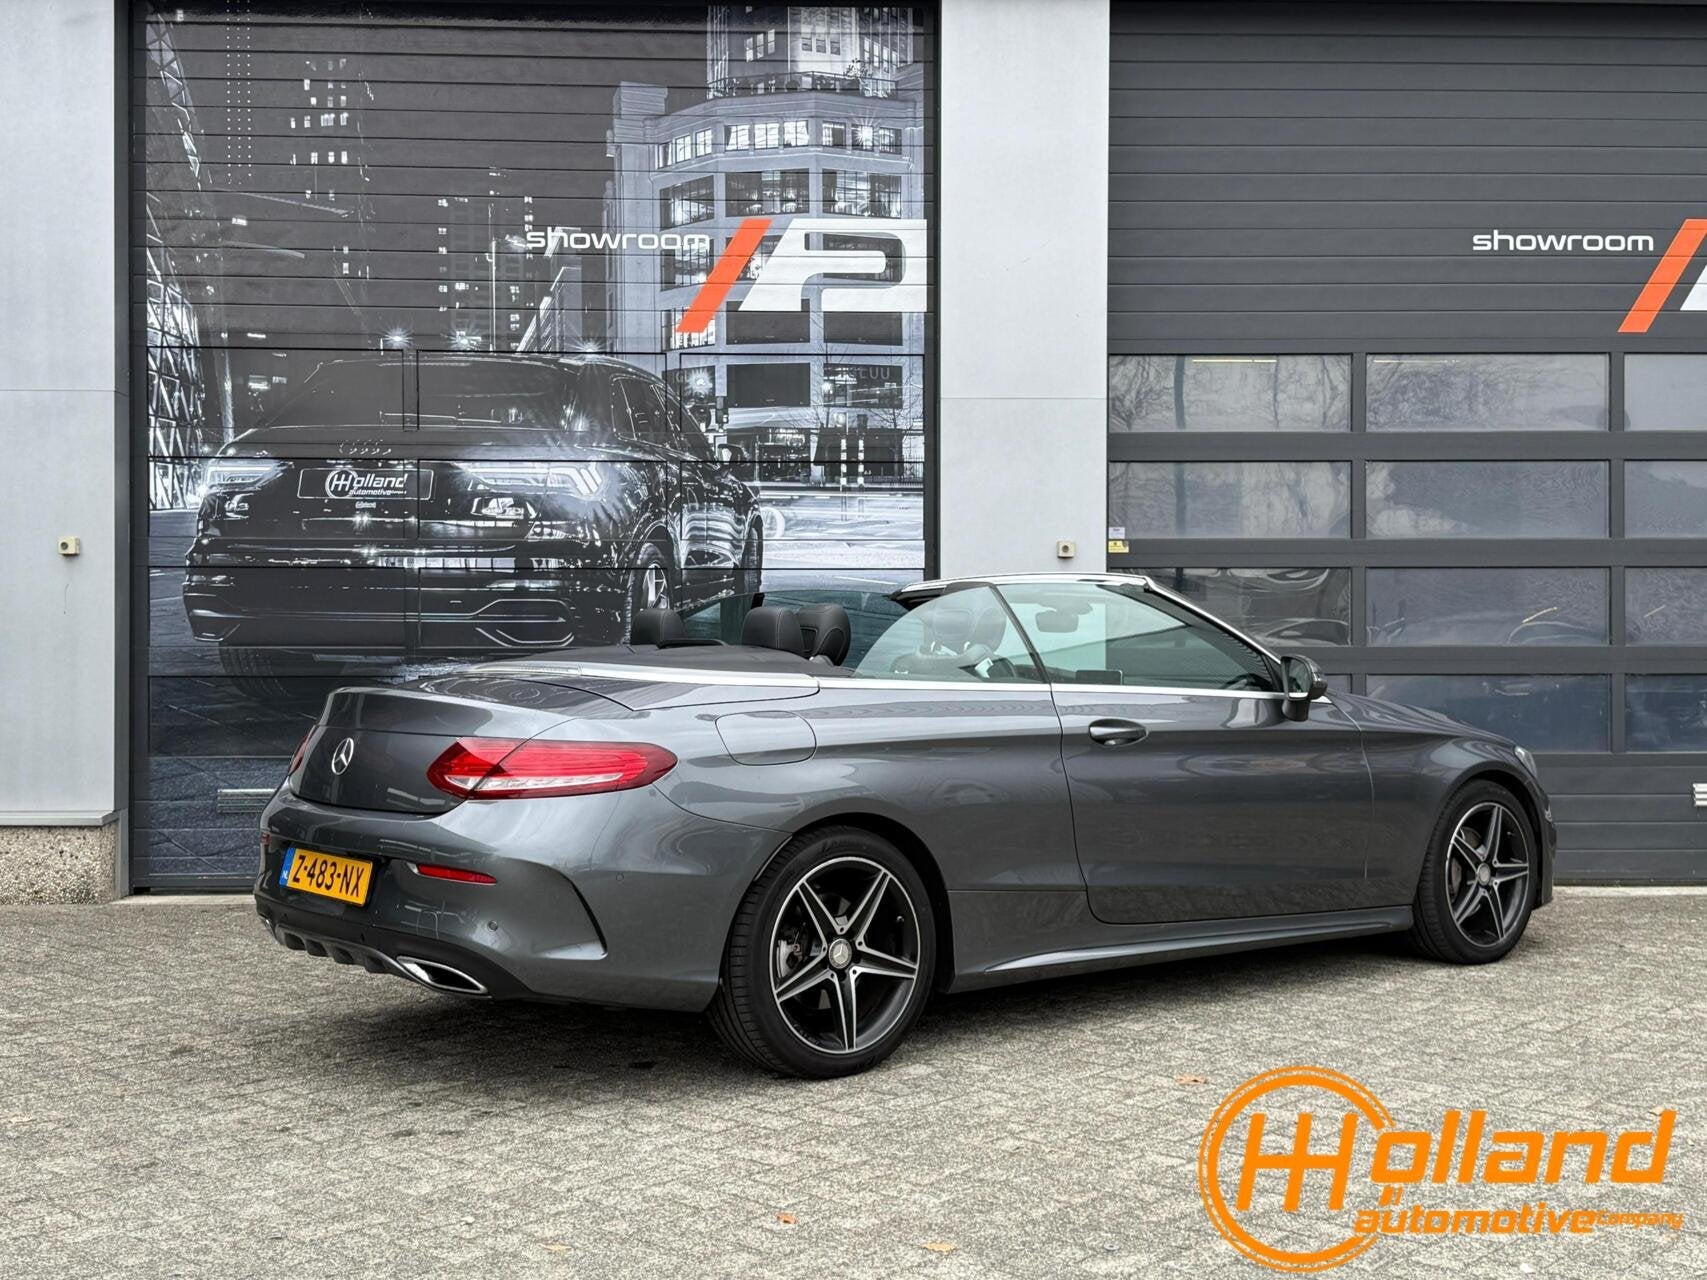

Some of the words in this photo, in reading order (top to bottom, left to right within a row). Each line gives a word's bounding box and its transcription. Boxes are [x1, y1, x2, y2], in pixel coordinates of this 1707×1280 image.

[526, 226, 710, 250] showroom
[1472, 229, 1654, 251] showroom
[292, 854, 364, 898] Z-483-NX
